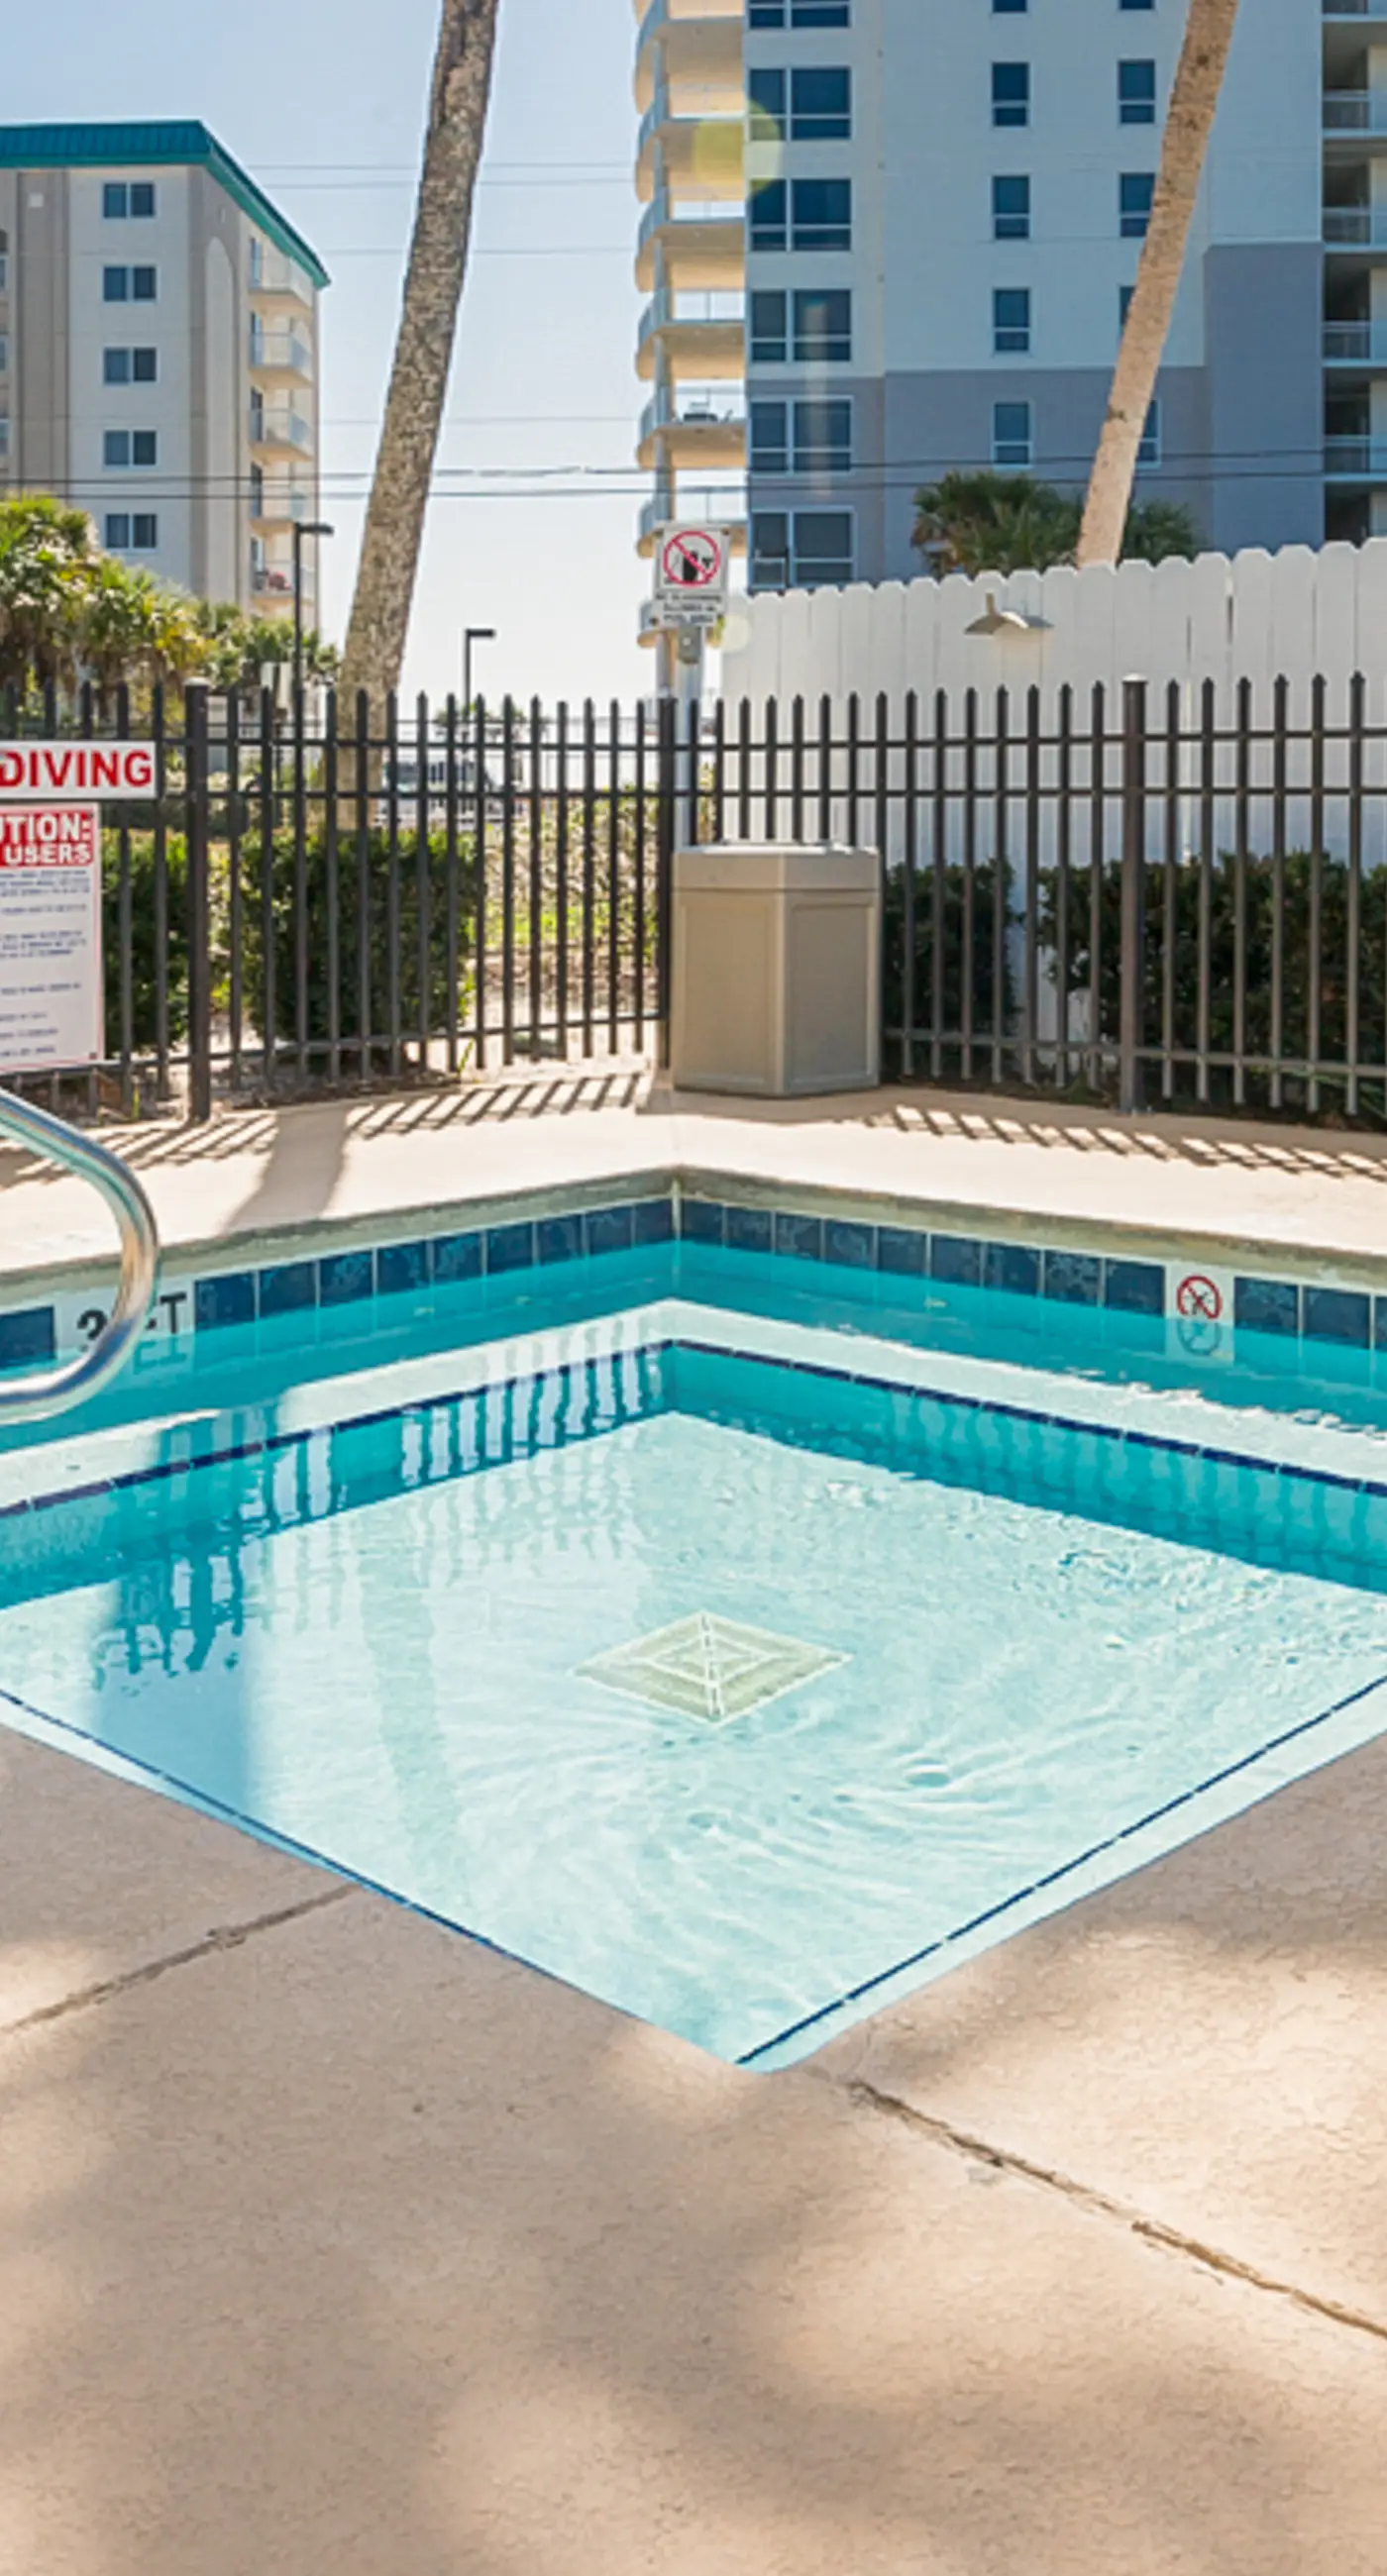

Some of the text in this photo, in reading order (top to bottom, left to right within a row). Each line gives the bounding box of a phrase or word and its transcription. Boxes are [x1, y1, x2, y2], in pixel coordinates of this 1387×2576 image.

[0, 750, 152, 787] DIVING
[0, 812, 91, 842] TION:
[5, 843, 91, 865] USERS
